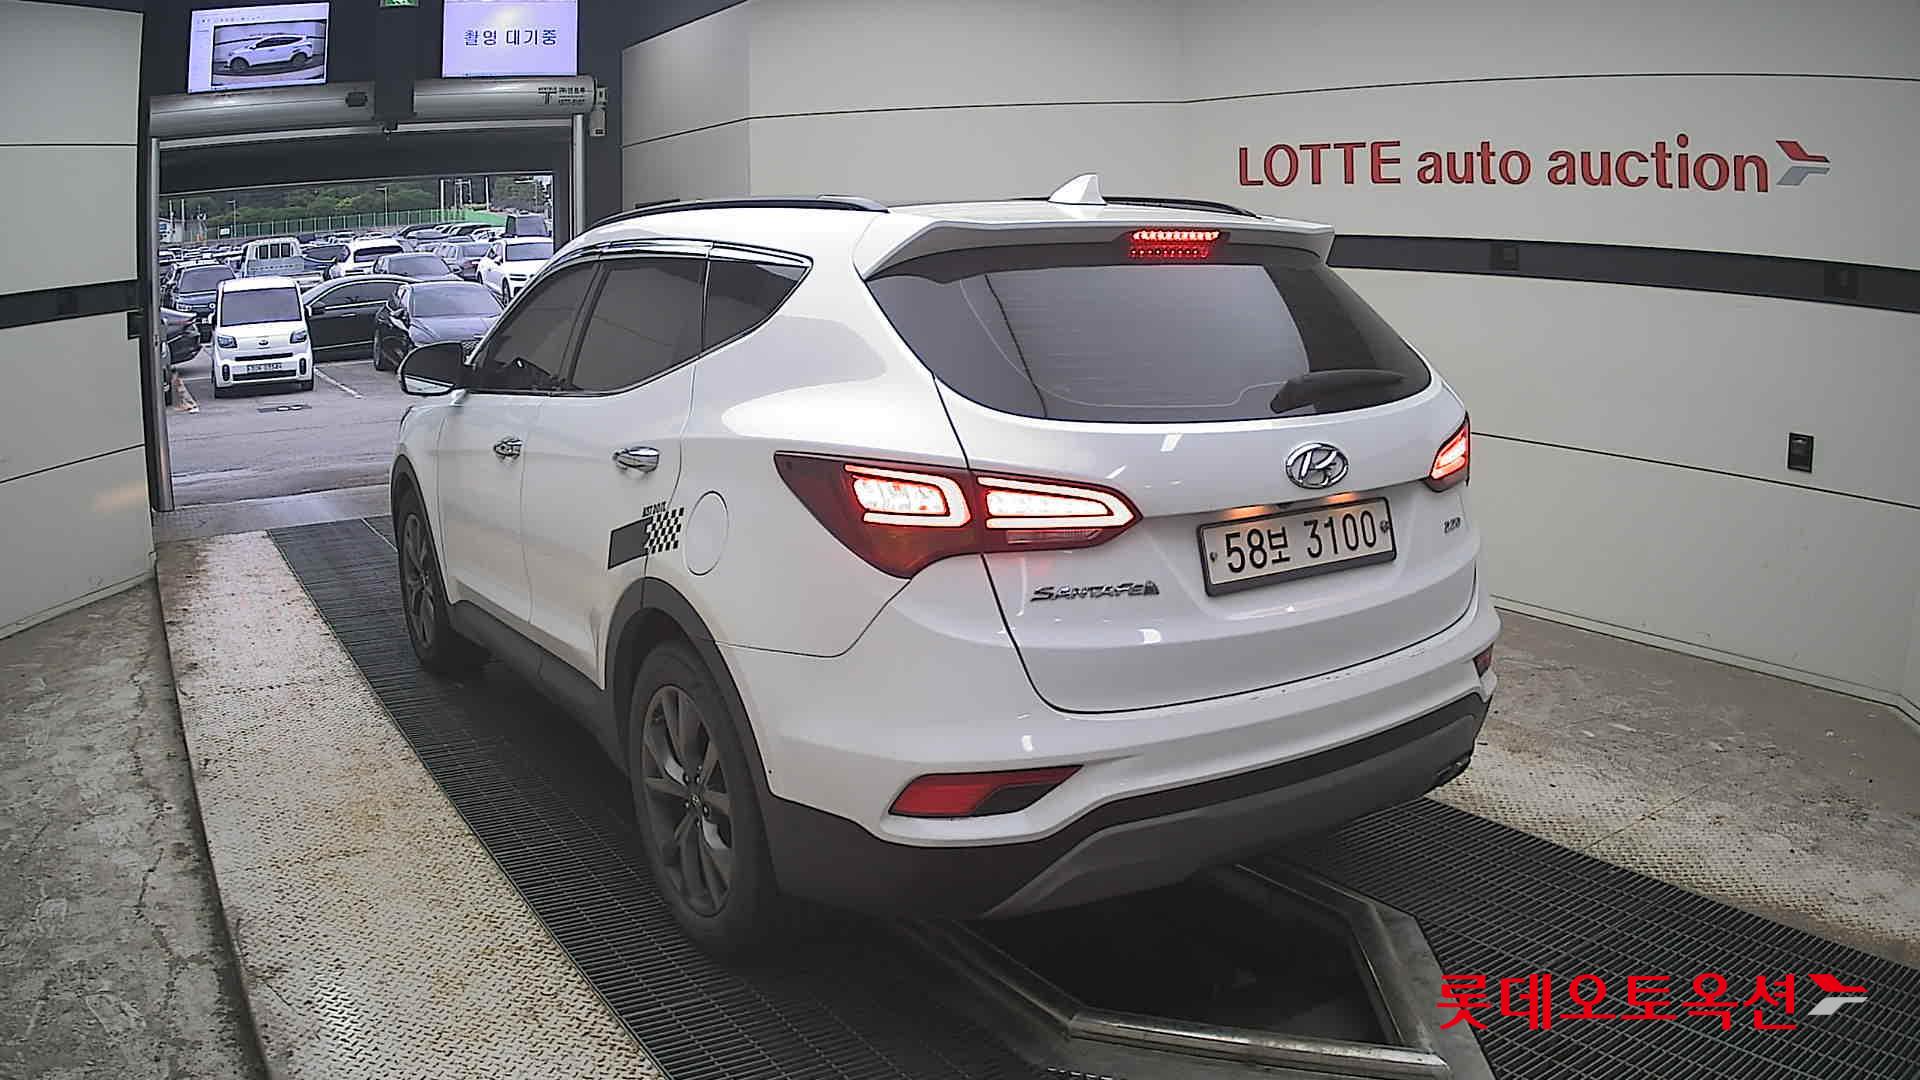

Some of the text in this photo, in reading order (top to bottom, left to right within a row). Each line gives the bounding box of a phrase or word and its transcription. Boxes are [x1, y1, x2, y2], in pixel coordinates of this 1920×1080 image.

[505, 28, 558, 46] 대기중
[1239, 133, 1769, 192] LOTTE auto auction
[1224, 509, 1378, 574] 58보 3100
